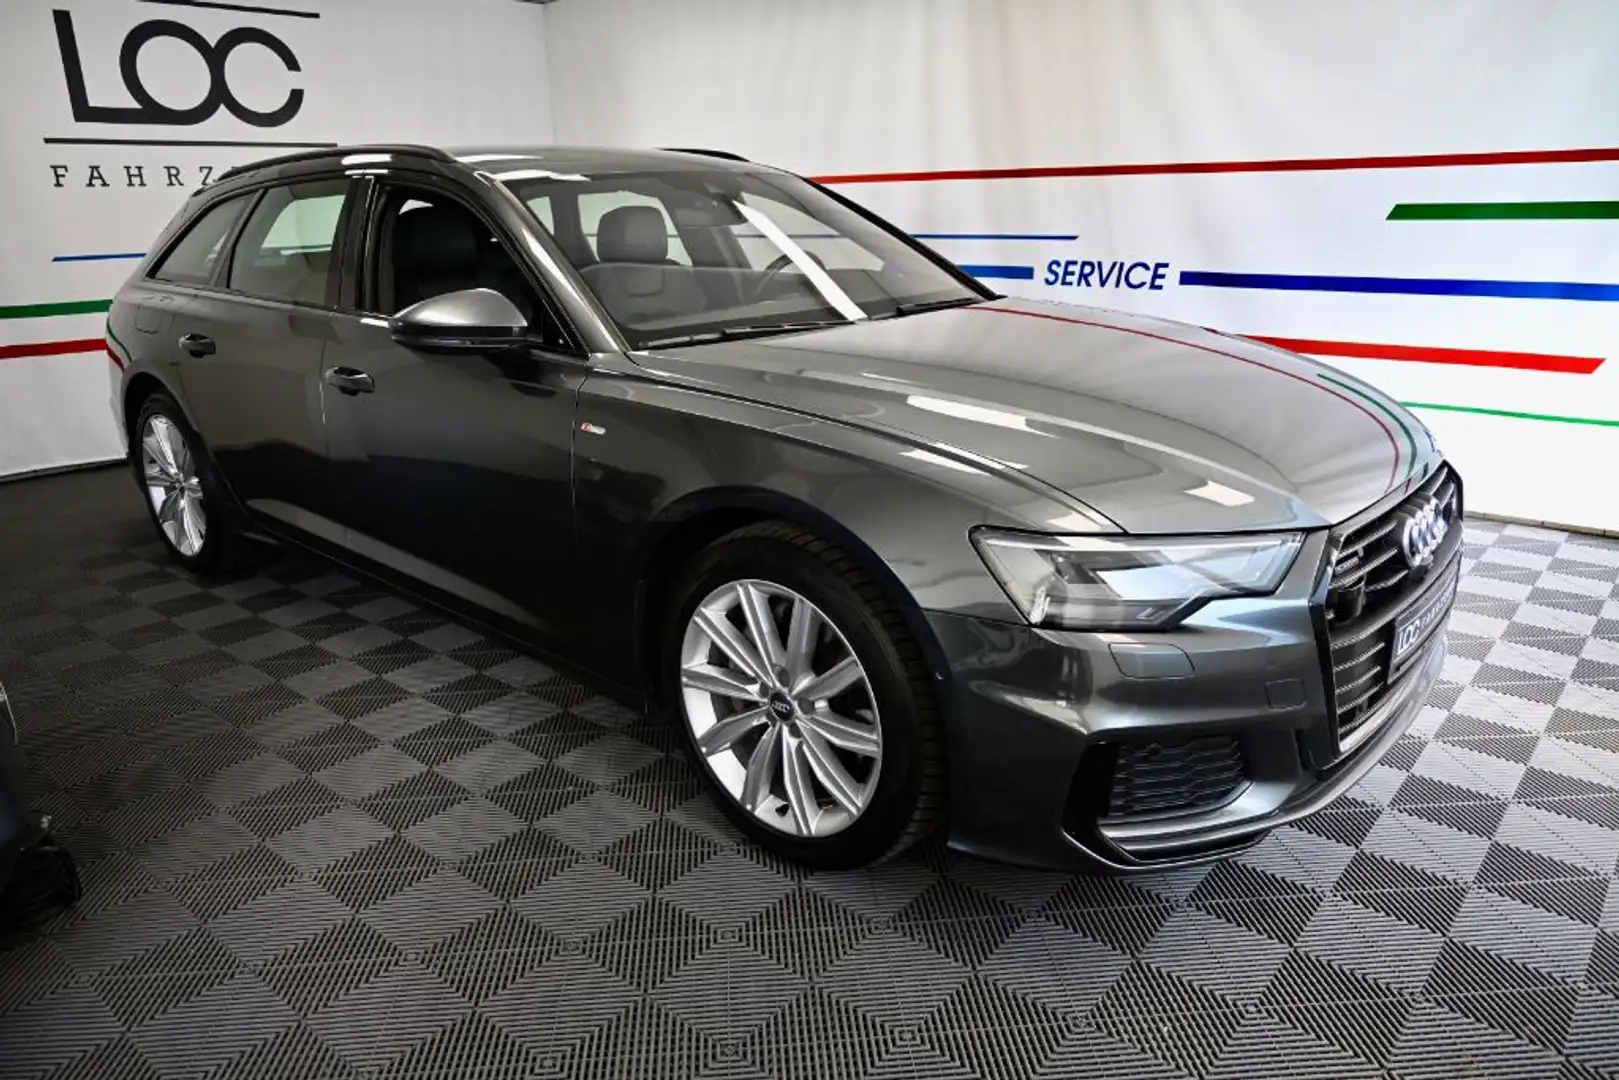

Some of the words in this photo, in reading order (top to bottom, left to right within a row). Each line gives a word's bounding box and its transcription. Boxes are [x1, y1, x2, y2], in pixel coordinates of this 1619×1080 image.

[52, 9, 305, 128] LOC
[49, 164, 240, 188] FAHRZ
[1044, 259, 1170, 291] SERVICE
